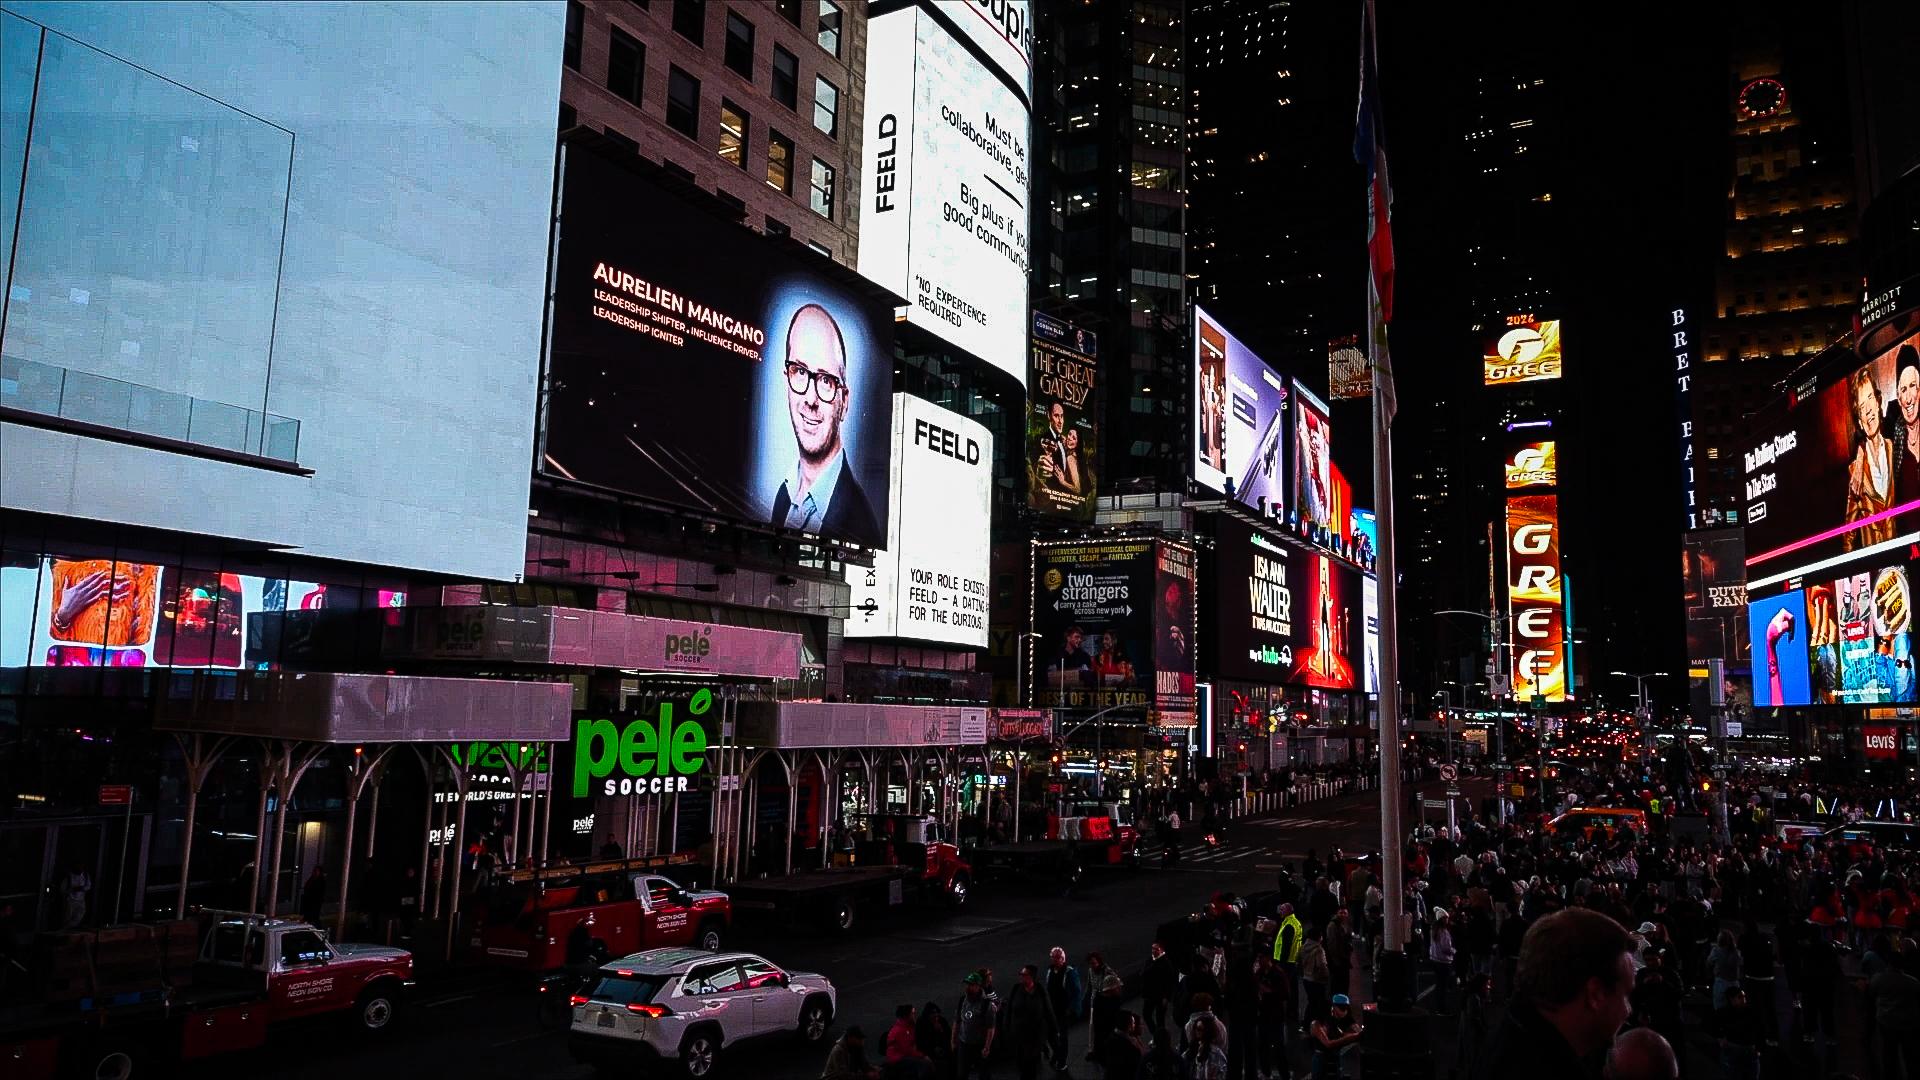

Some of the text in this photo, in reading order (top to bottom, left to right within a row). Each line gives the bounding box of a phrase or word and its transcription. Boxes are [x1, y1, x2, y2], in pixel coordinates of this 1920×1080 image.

[985, 112, 1025, 162] Must be
[876, 113, 897, 215] FEELD
[943, 201, 973, 233] good
[960, 182, 980, 215] Big
[982, 202, 1004, 231] plus
[1007, 217, 1014, 236] if
[593, 262, 764, 346] AURELIEN MANGANO
[918, 293, 962, 328] REQUIRED
[936, 286, 987, 327] EXPERIENCE
[1861, 286, 1902, 315] MARRIOTT
[1862, 301, 1896, 328] MARQUIS
[593, 305, 684, 347] LEADERSHIP IGNITER
[594, 288, 651, 317] LEADERSHIP
[690, 326, 732, 350] INFLUENCE
[1506, 313, 1535, 326] 2026
[1671, 308, 1690, 392] BRET
[1033, 348, 1097, 389] THE GREAT
[1489, 361, 1554, 380] GREE
[1040, 373, 1089, 406] GATSBY
[915, 418, 980, 466] FEELD
[1744, 452, 1756, 474] The
[1755, 442, 1776, 467] Rolling
[1508, 471, 1557, 482] GREE
[1751, 478, 1762, 498] The
[1760, 472, 1777, 494] Stars
[910, 568, 986, 597] YOUR ROLE EXISTS
[1067, 572, 1094, 587] two
[1254, 554, 1286, 586] LISA ANN
[909, 586, 938, 605] FEELD
[952, 594, 959, 608] A
[962, 595, 985, 613] DATING
[1061, 586, 1129, 603] strangers
[1249, 576, 1291, 622] WALTER
[1512, 523, 1556, 683] GREE
[909, 605, 984, 630] FOR THE CURIOUS.
[1074, 607, 1095, 615] across
[1110, 605, 1125, 616] york
[665, 626, 712, 660] pelé
[1262, 644, 1278, 665] hulu
[673, 654, 701, 663] SOCCER
[1690, 658, 1706, 666] MAY
[1070, 691, 1086, 706] OF
[1087, 691, 1112, 706] THE
[573, 688, 711, 798] pelé
[604, 776, 689, 797] SOCCER
[573, 813, 595, 831] pelé
[287, 988, 306, 998] NEON
[288, 977, 335, 991] NORTH SHORE
